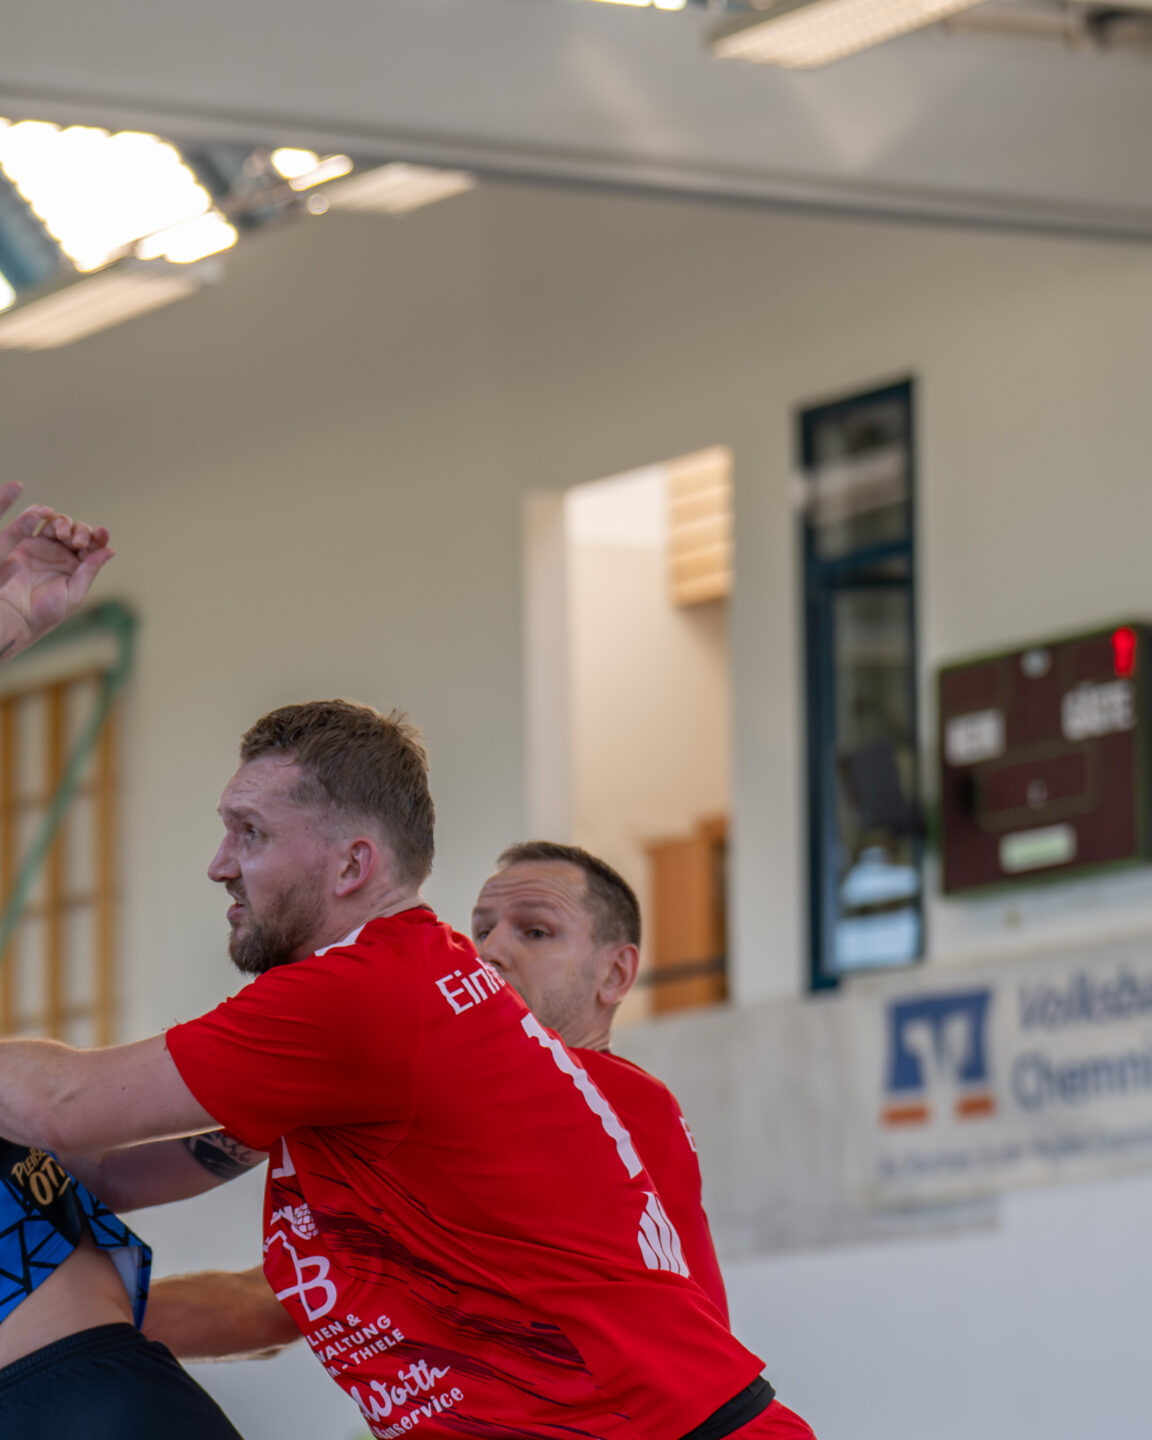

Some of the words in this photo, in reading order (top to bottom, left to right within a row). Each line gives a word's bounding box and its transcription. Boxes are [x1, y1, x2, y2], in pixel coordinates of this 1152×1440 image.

[347, 1313, 362, 1329] &
[350, 1328, 405, 1369] THIELE
[350, 1359, 451, 1422] Woith
